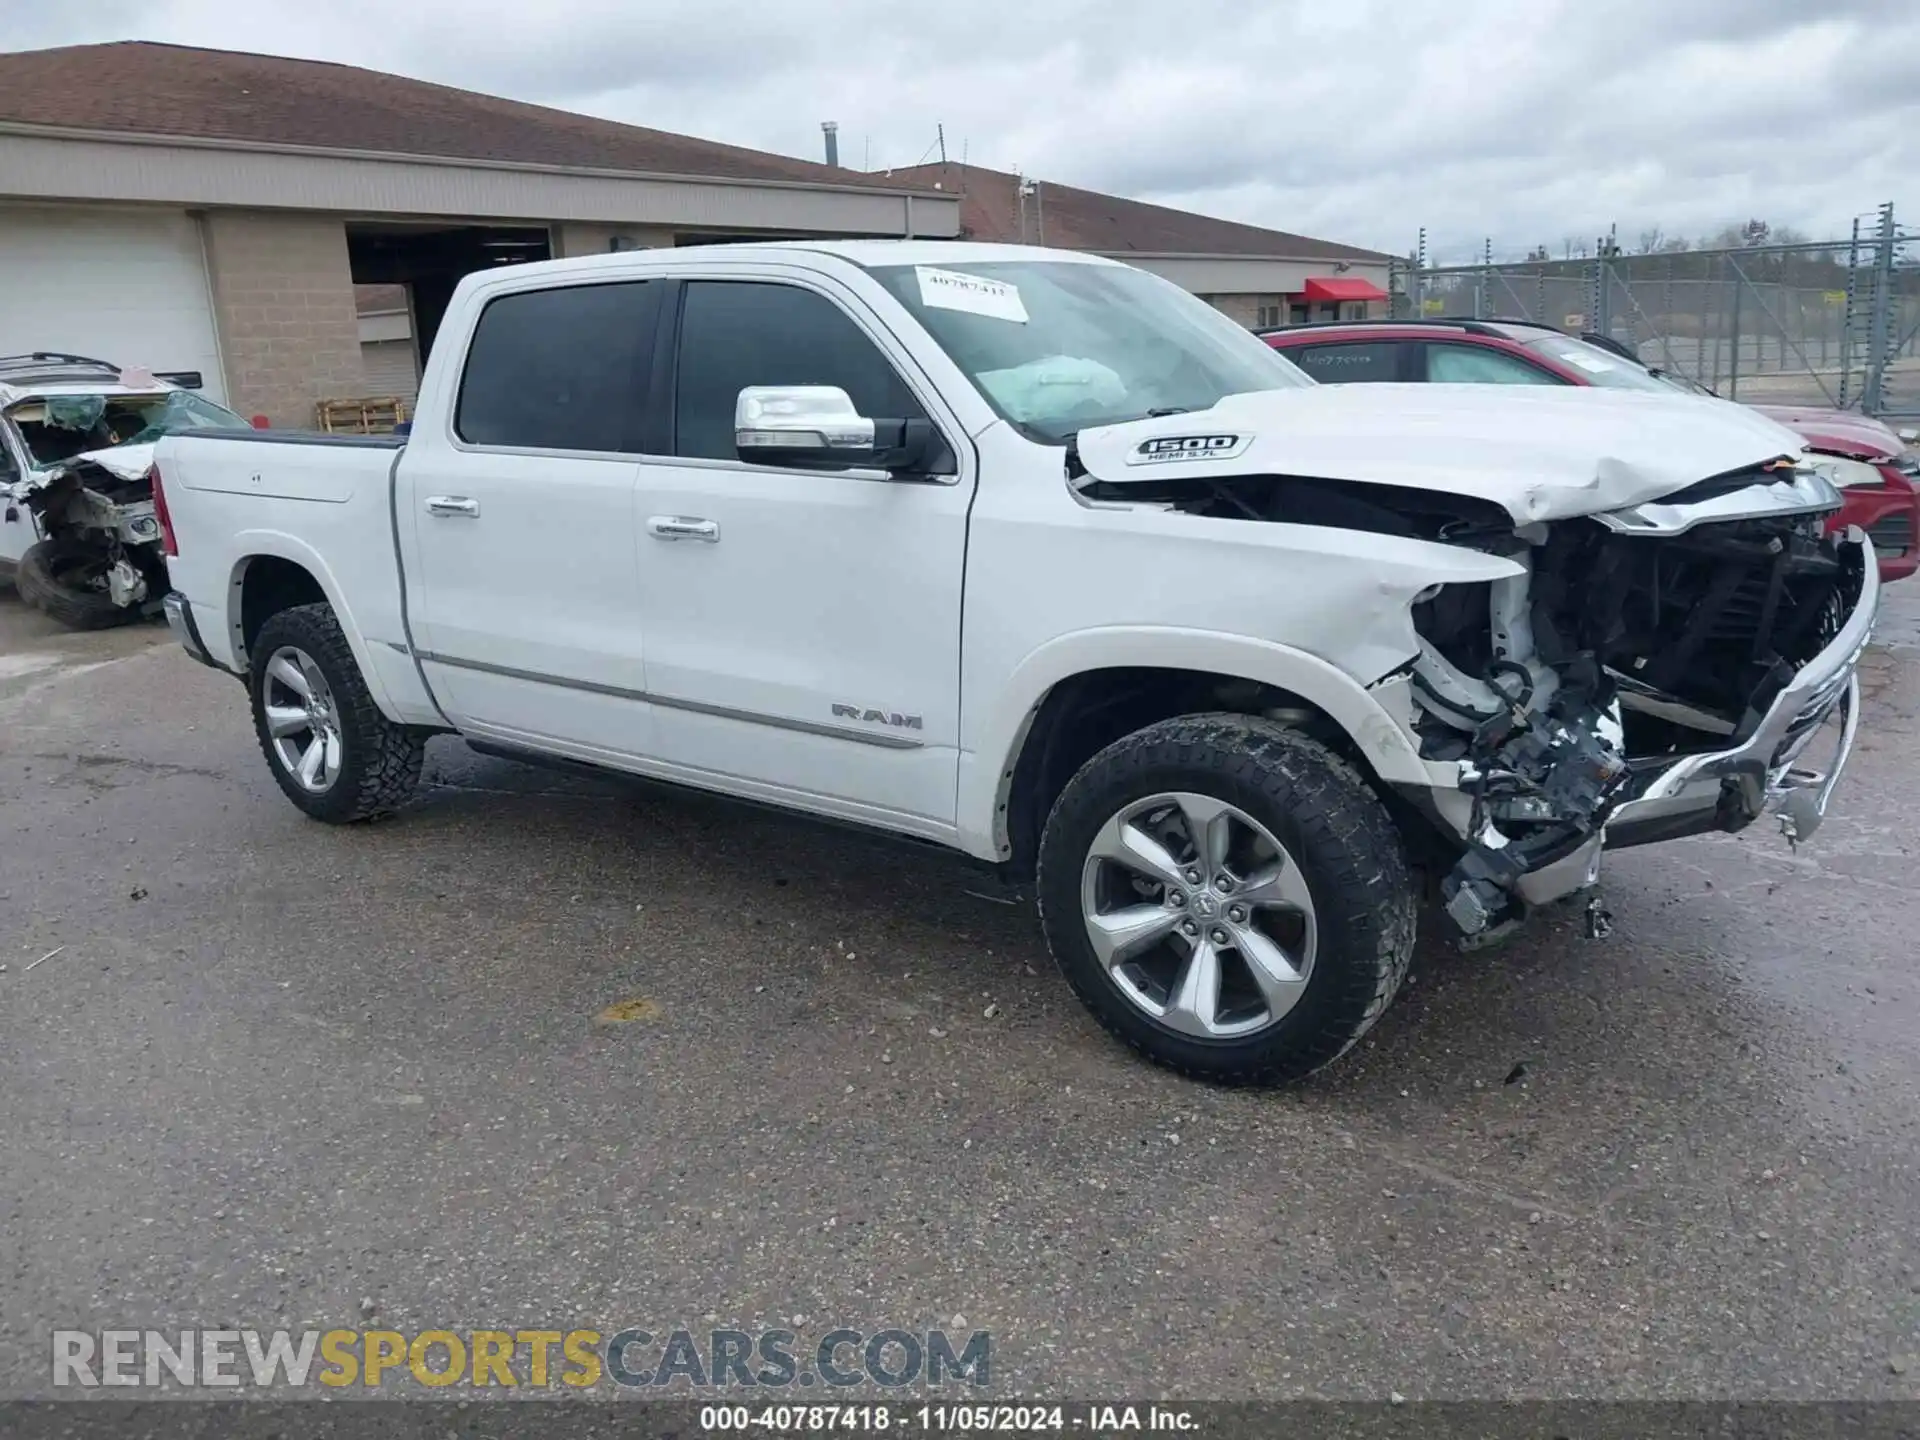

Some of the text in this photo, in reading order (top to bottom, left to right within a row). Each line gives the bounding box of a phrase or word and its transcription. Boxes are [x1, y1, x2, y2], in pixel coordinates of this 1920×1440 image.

[1147, 437, 1233, 453] 1500
[1147, 450, 1184, 461] HEMI
[831, 702, 923, 730] RAM
